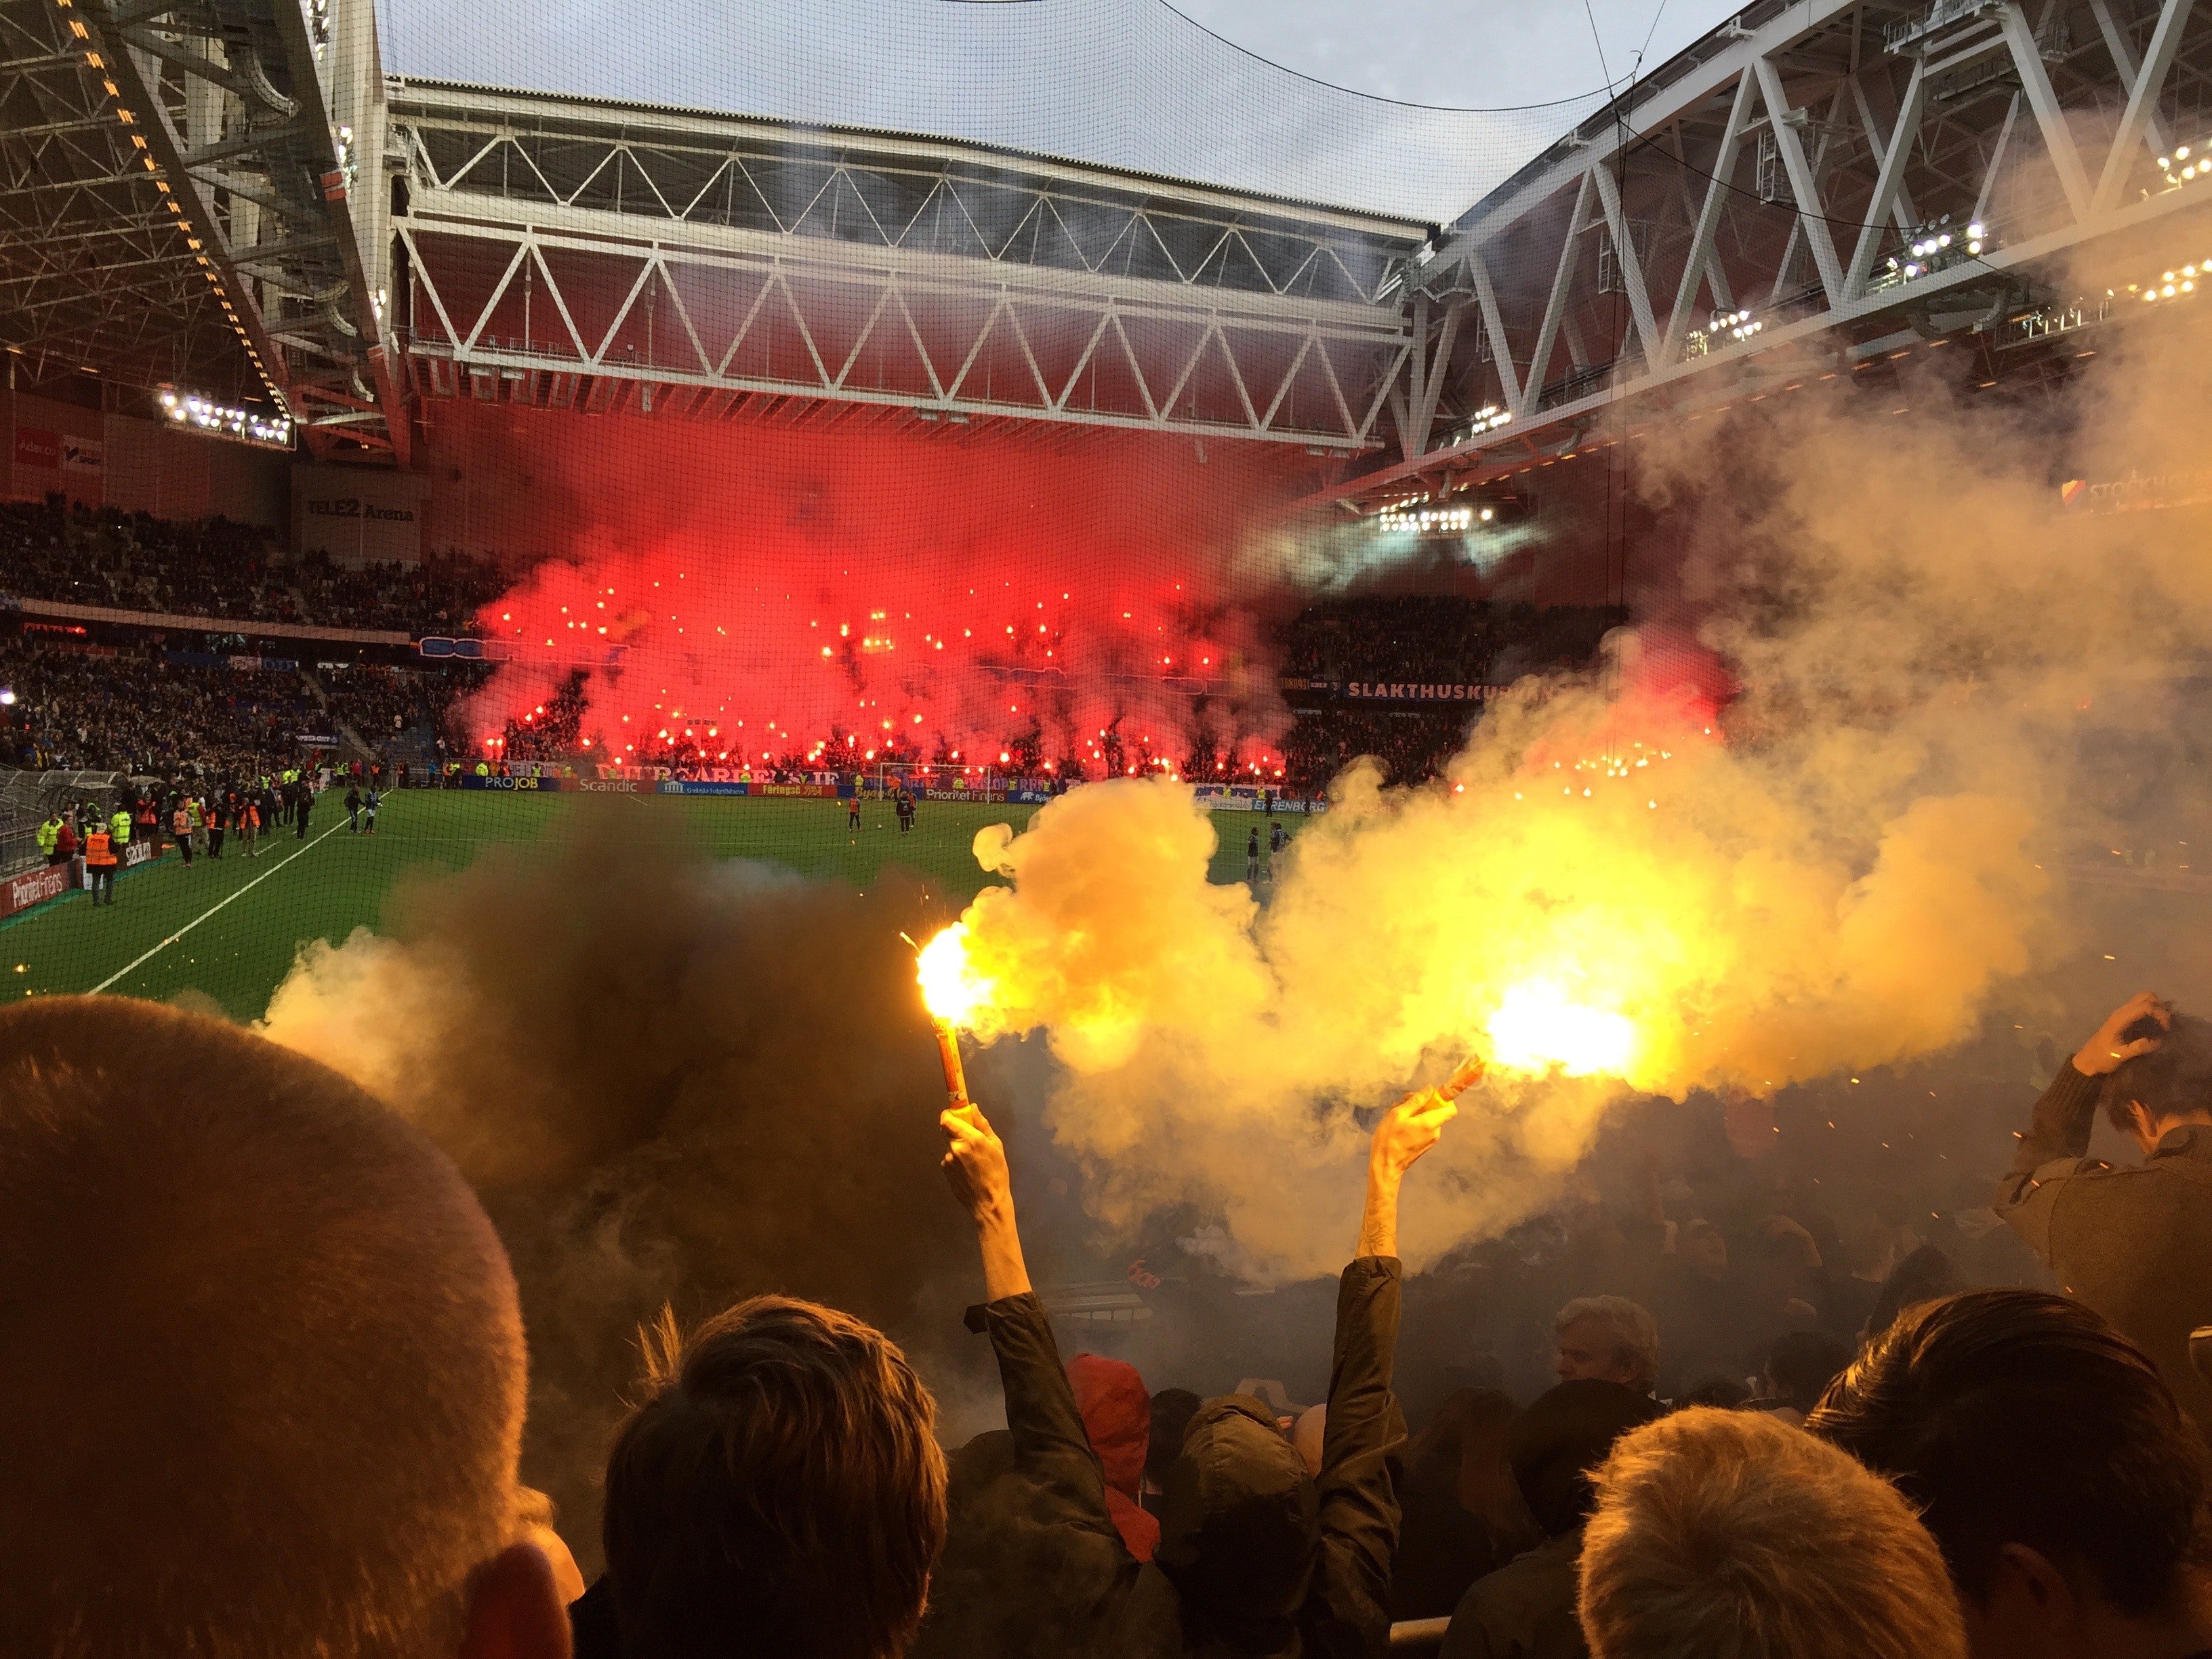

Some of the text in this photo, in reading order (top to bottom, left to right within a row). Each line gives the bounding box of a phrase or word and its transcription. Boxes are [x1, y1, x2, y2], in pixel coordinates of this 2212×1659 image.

[308, 499, 414, 522] TELE2 Arena
[485, 777, 539, 790] PROJOB
[813, 771, 839, 785] IF
[579, 779, 638, 792] Scandic
[926, 788, 1005, 802] Prioritet Finans
